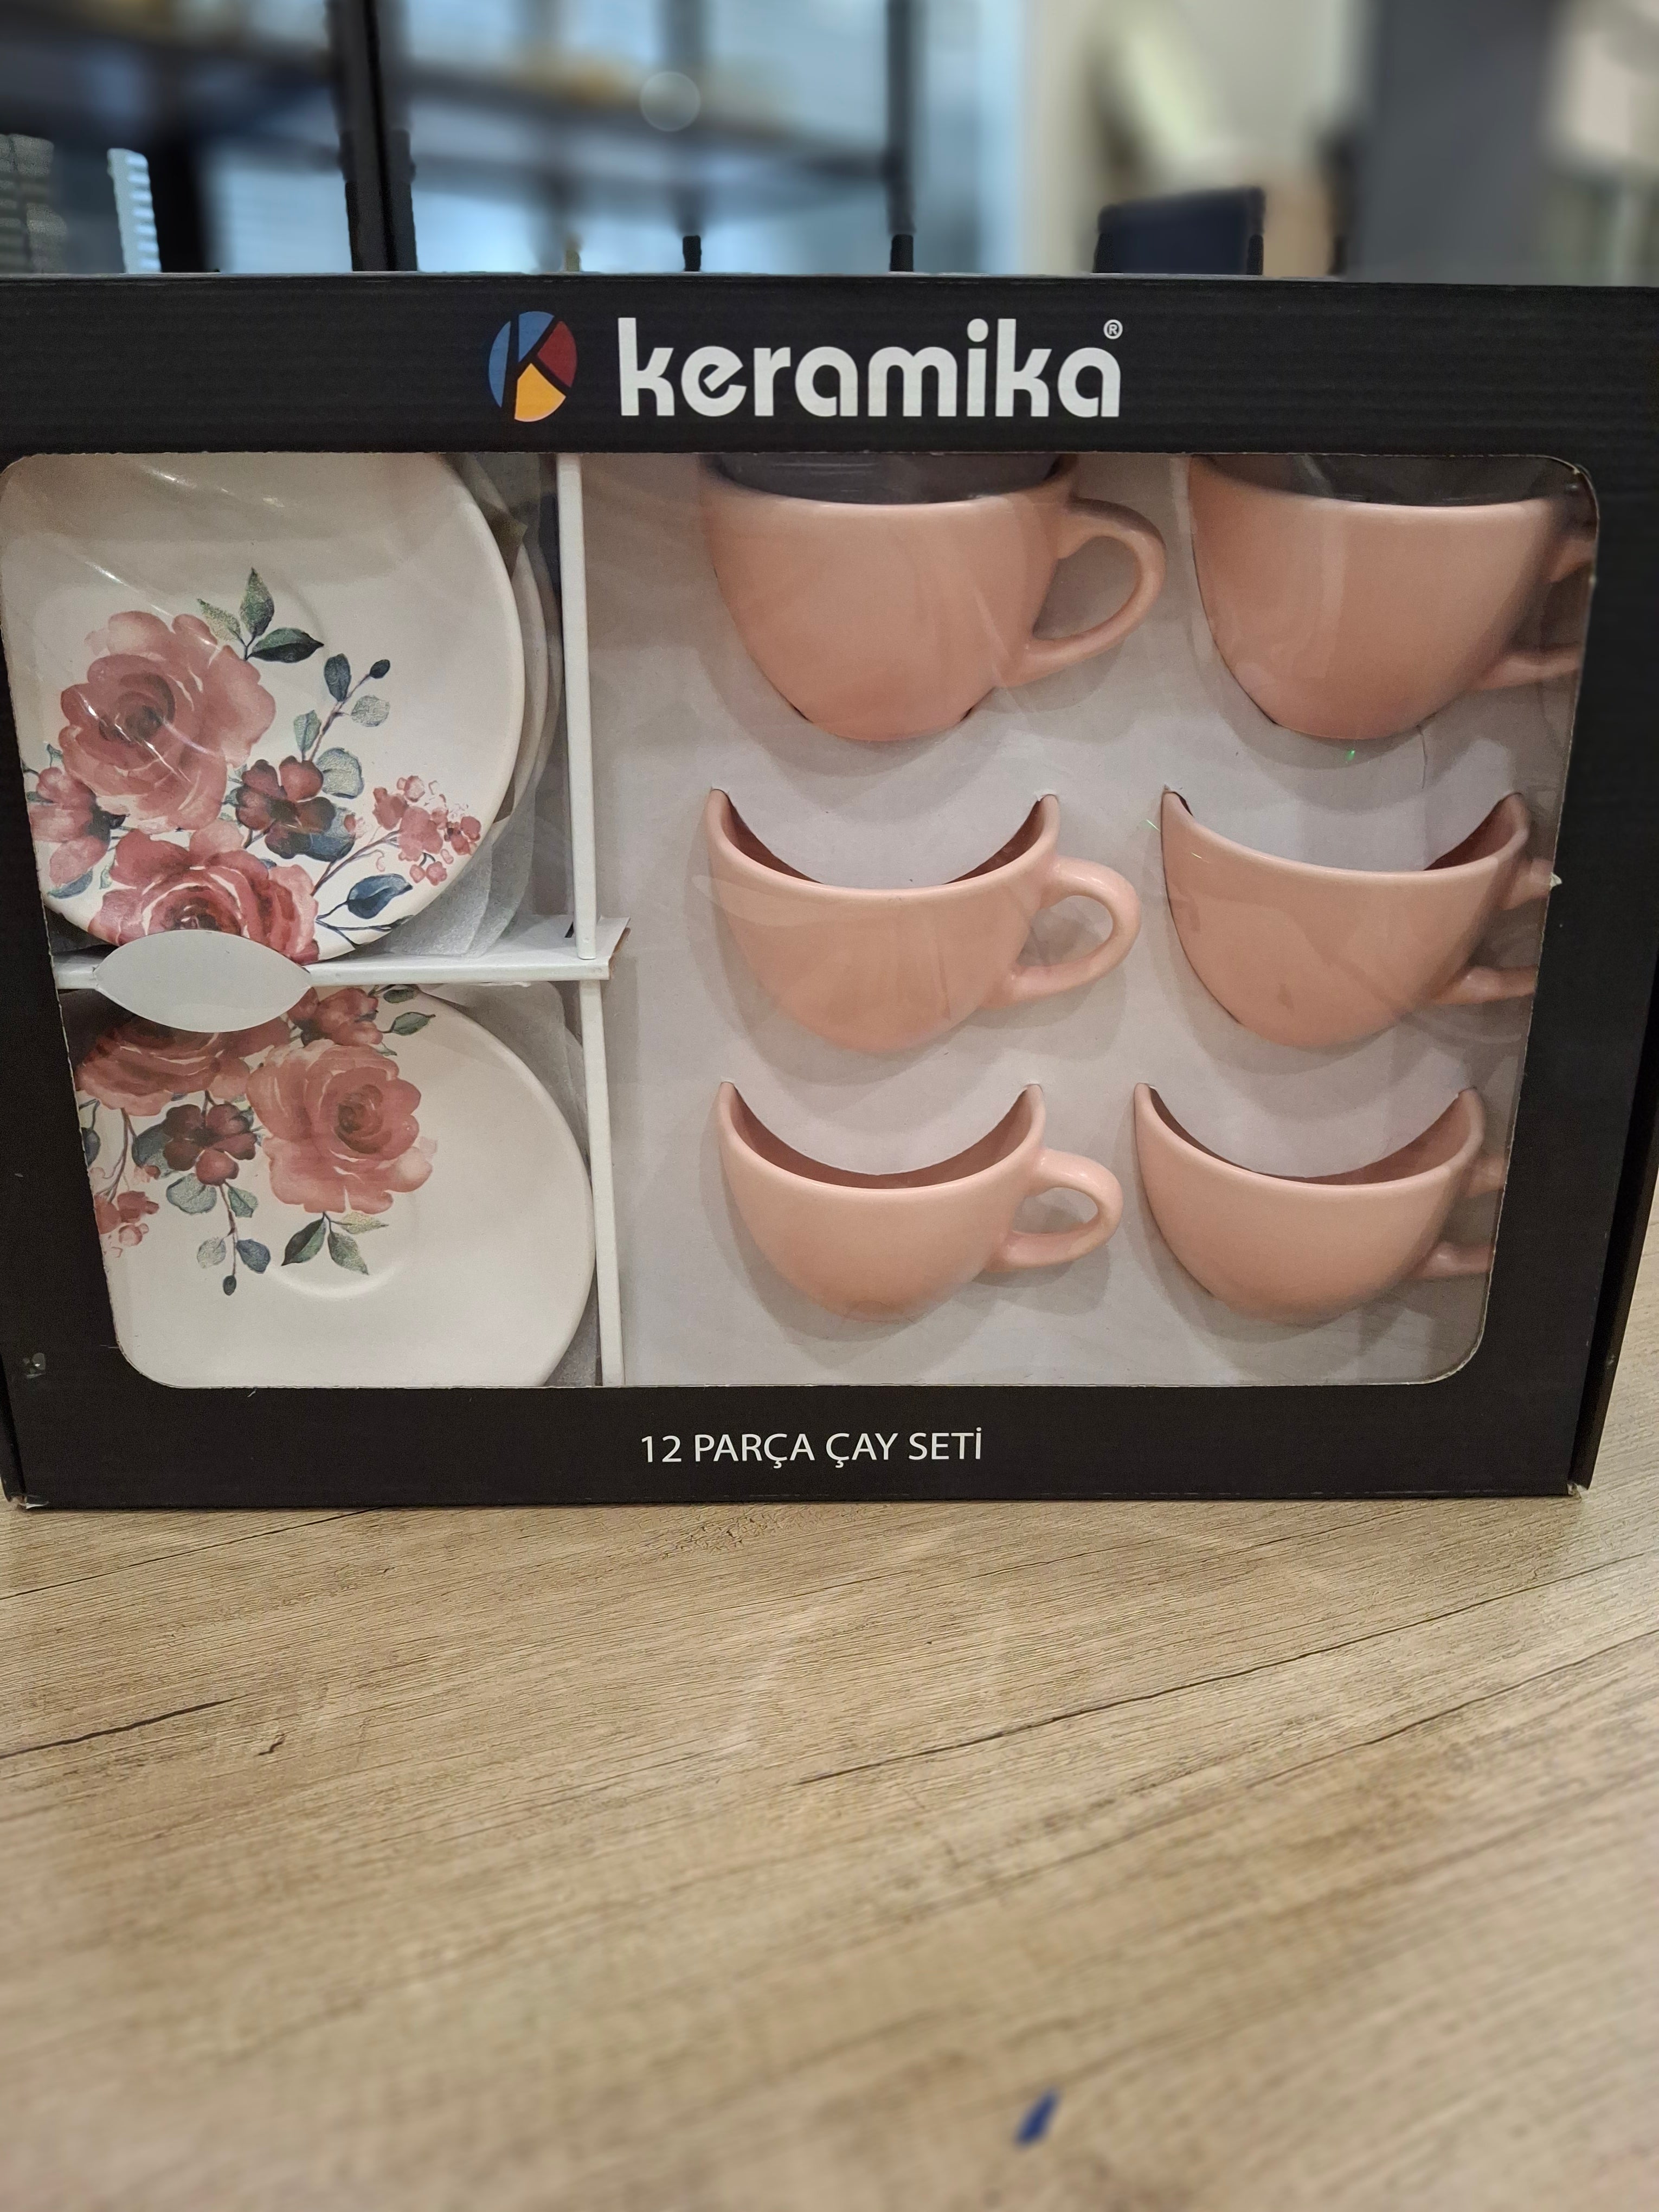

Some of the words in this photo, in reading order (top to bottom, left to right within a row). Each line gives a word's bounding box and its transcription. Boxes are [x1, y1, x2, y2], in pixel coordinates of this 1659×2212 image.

[641, 1435, 682, 1462] 12
[695, 1433, 815, 1468] PARÇA
[826, 1433, 898, 1468] ÇAY
[909, 1427, 982, 1459] SETİ
